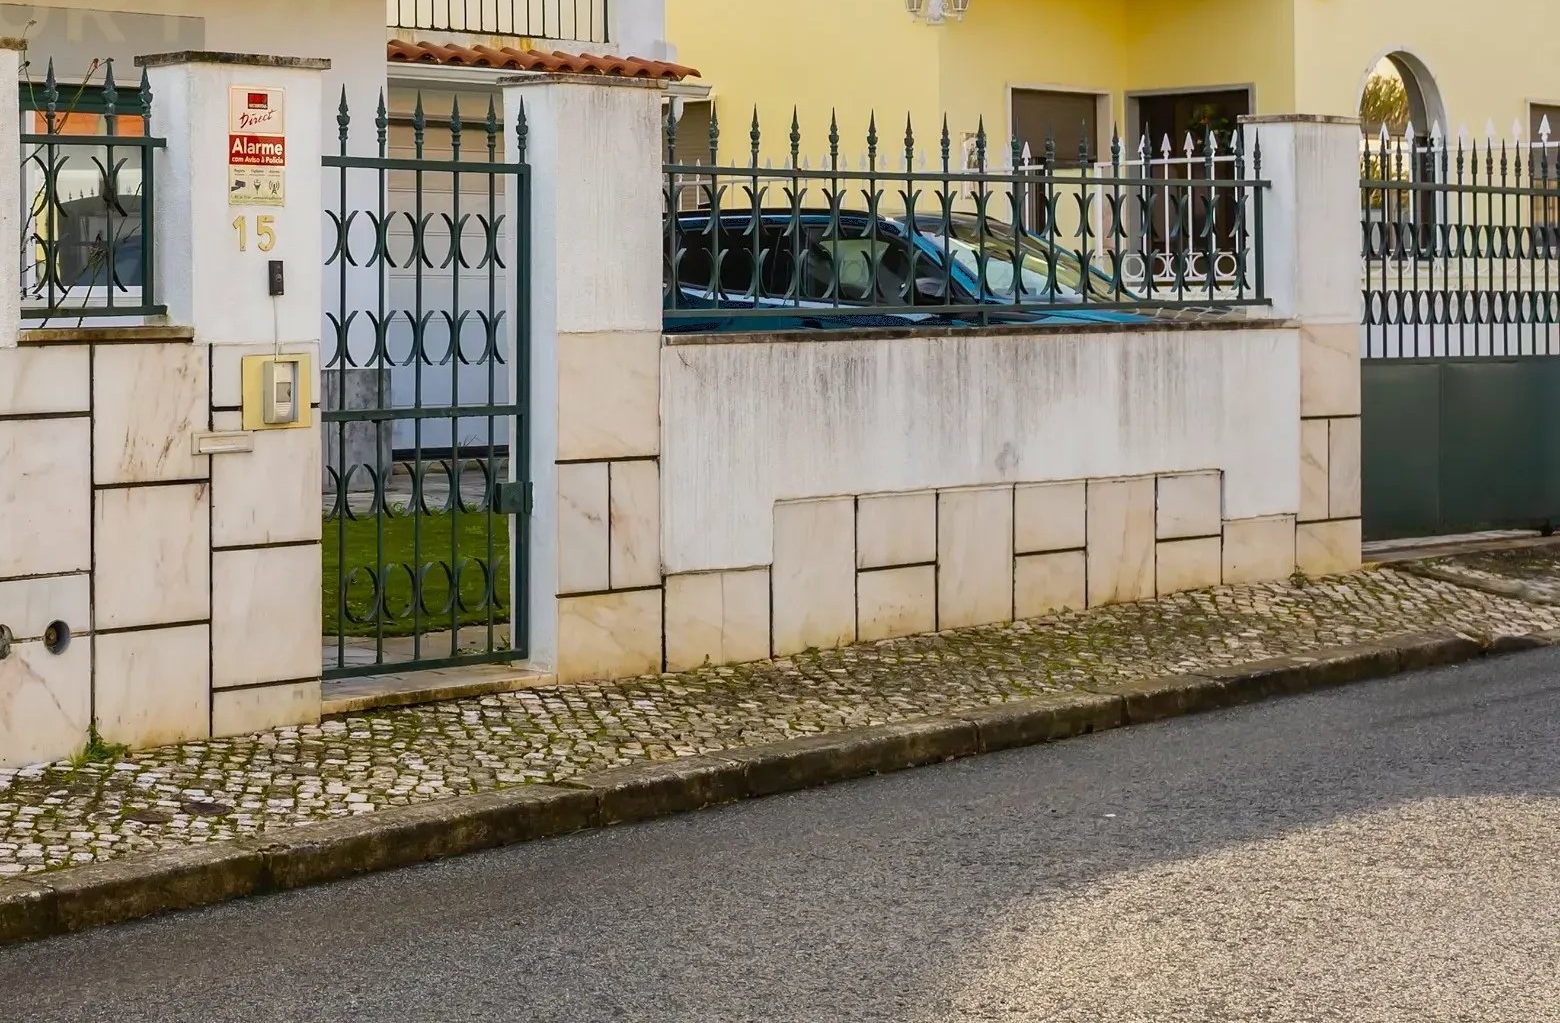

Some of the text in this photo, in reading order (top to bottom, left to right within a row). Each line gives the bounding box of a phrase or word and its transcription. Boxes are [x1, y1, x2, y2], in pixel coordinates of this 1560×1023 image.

[239, 109, 277, 129] Direct
[232, 137, 283, 155] Alarme
[232, 215, 276, 251] 15
